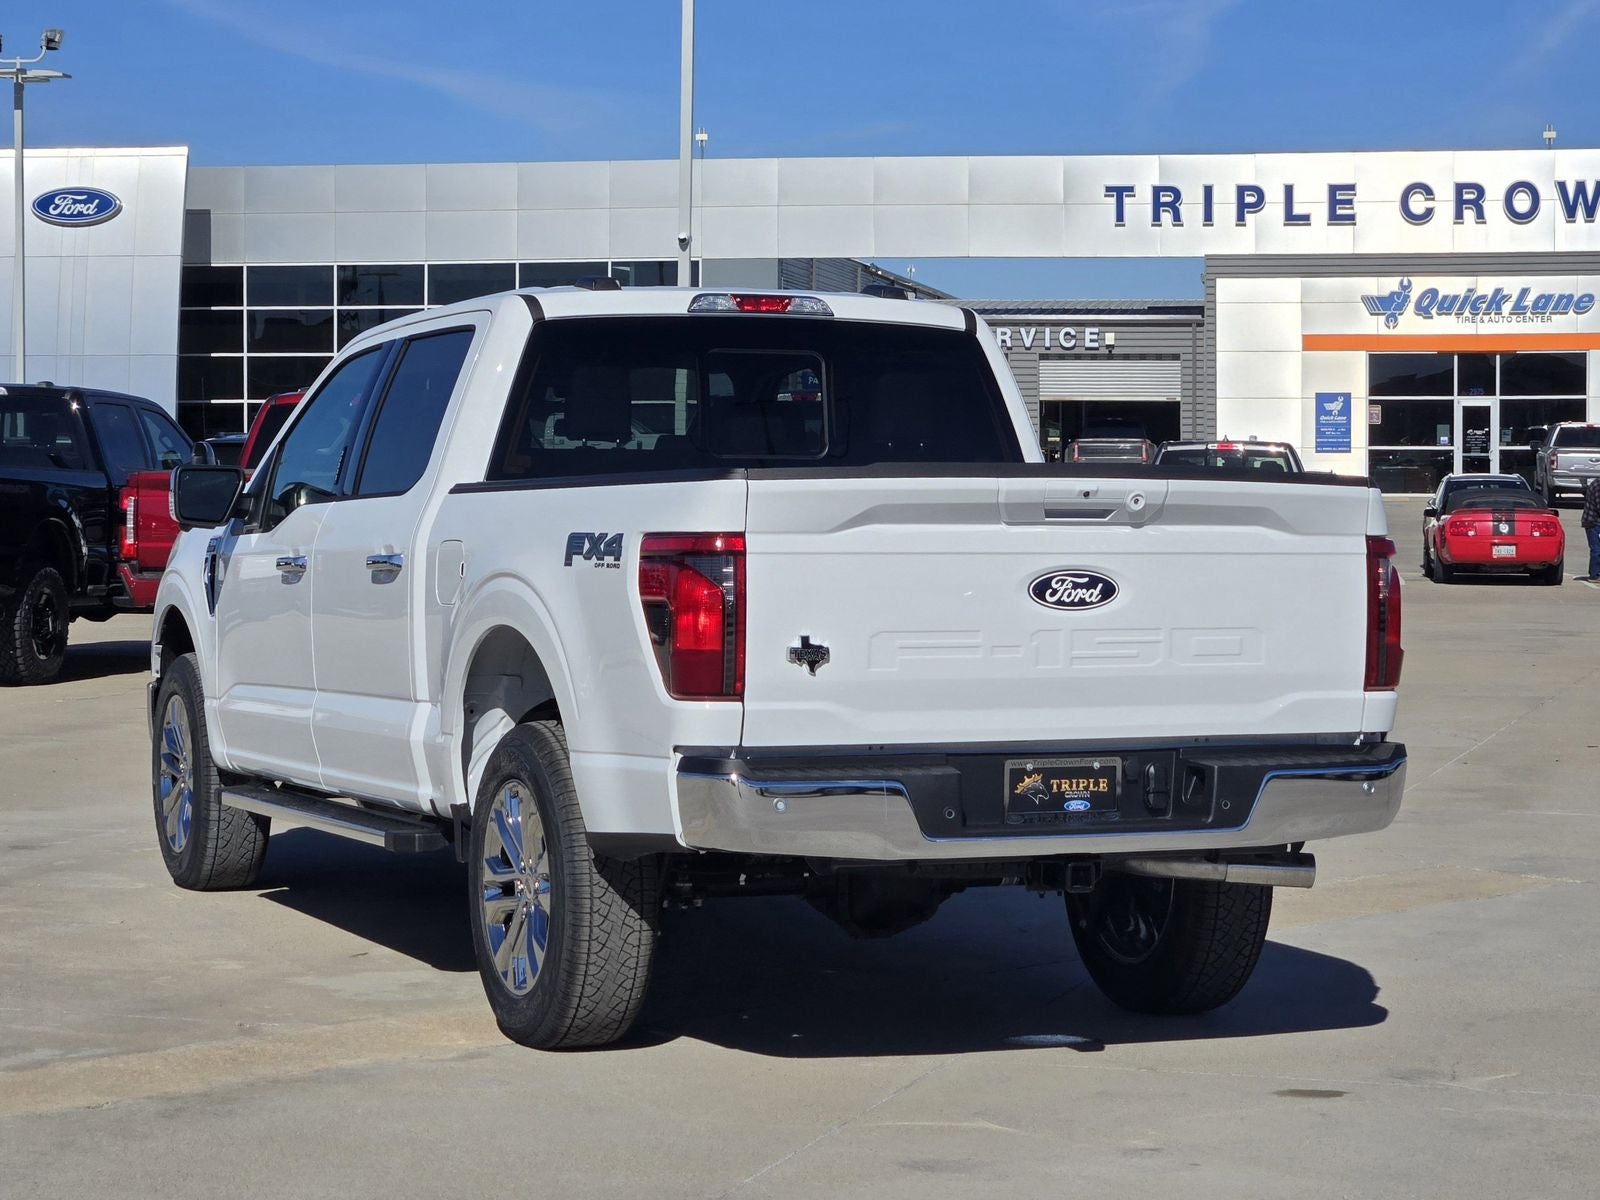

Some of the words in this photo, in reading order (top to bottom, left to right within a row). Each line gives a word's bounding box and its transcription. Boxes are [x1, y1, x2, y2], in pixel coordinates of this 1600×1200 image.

[48, 194, 99, 215] Ford
[1104, 183, 1357, 227] TRIPLE
[1400, 180, 1600, 225] CROW
[1414, 287, 1512, 319] Quick
[1509, 287, 1596, 315] Lane
[1455, 316, 1476, 324] TIRE
[1479, 316, 1486, 324] &
[1487, 316, 1513, 324] AUTO
[1515, 315, 1553, 324] CENTER
[564, 532, 624, 567] FX4
[1045, 576, 1103, 602] Ford
[867, 627, 1265, 671] F-150
[1050, 778, 1108, 793] TRIPLE
